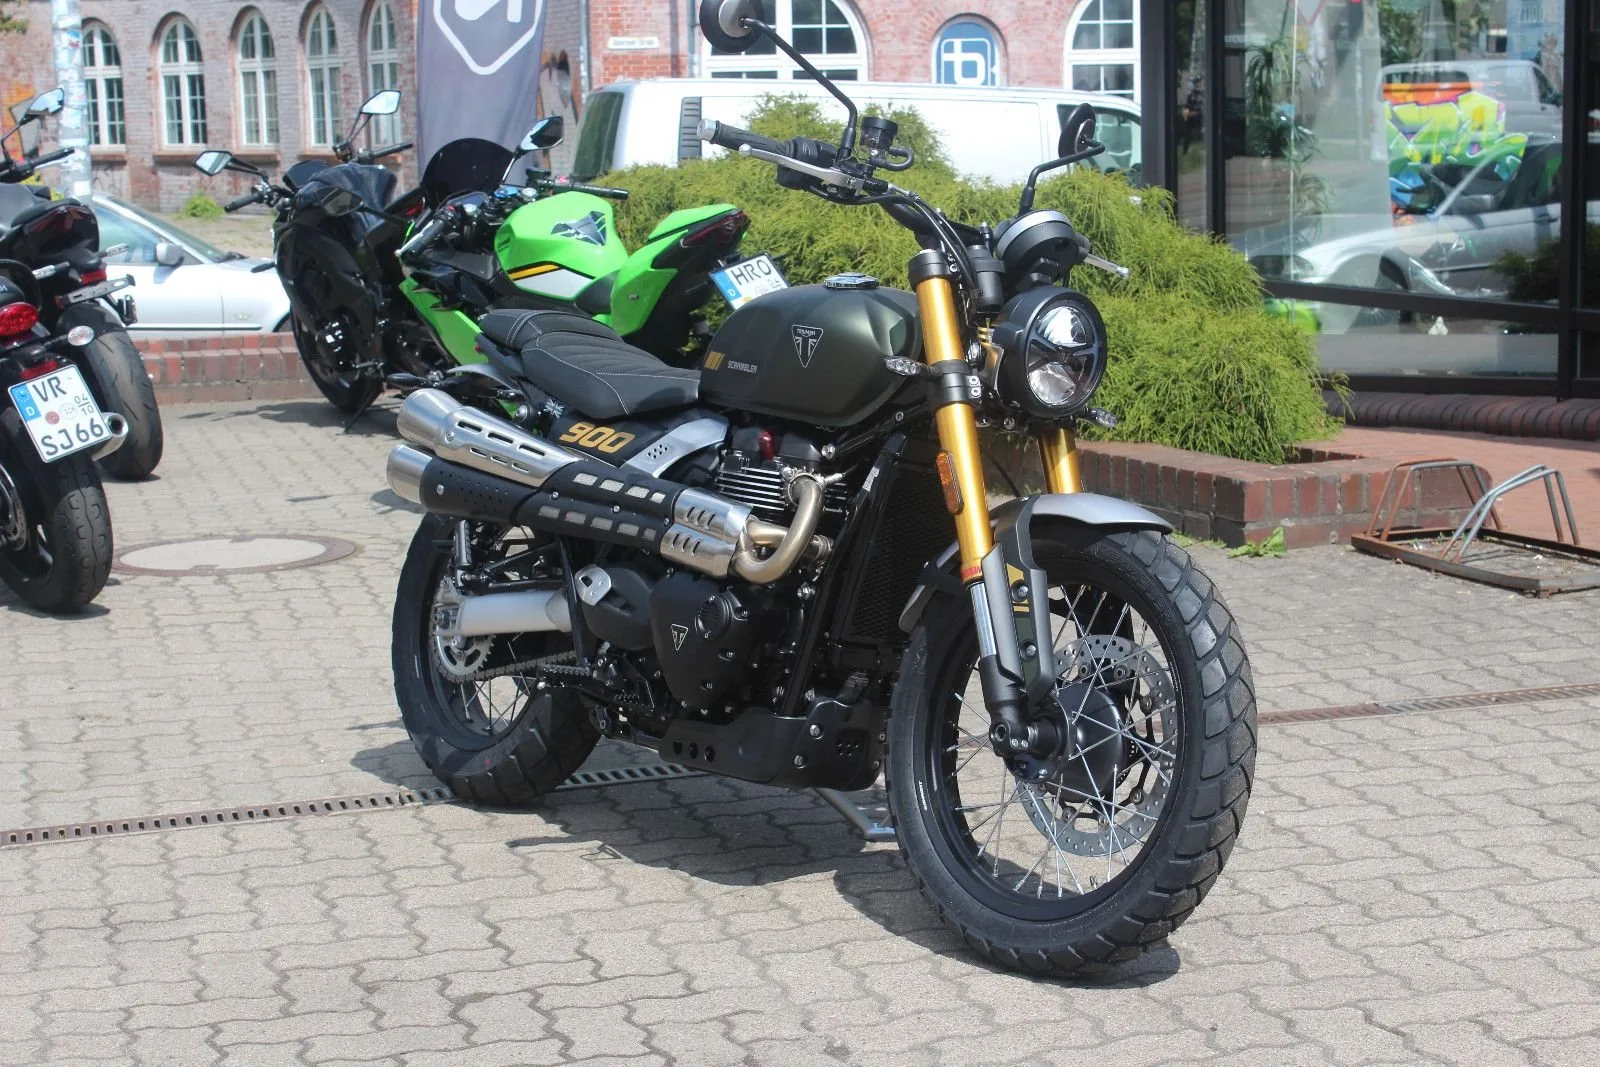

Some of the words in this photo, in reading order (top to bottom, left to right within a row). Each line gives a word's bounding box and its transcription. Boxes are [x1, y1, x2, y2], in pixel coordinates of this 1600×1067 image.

[731, 259, 772, 286] HRO
[727, 288, 736, 296] D
[727, 360, 758, 374] SCRAMBLER
[32, 376, 67, 402] VR
[25, 406, 35, 417] D
[559, 421, 636, 454] 900
